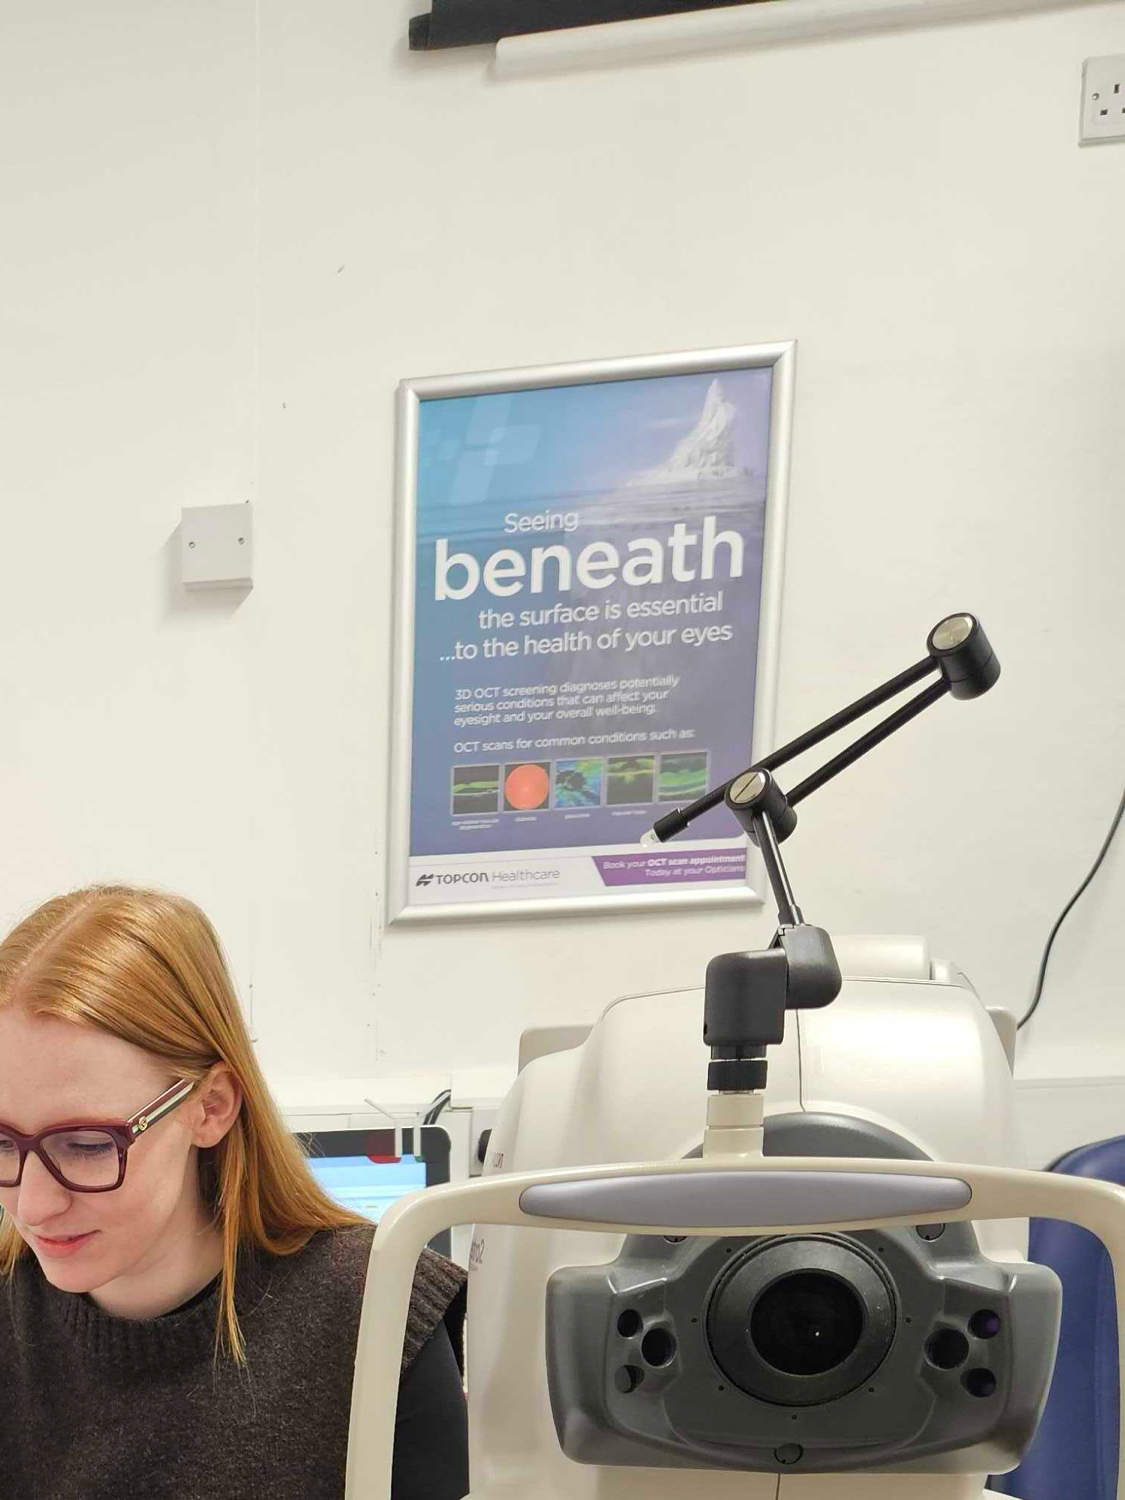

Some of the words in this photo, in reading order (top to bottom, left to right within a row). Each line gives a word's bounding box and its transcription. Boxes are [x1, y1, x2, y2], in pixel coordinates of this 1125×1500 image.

[504, 509, 579, 533] Seeing
[434, 515, 745, 601] beneath
[478, 608, 513, 629] the
[520, 603, 598, 626] surface
[604, 600, 622, 620] is
[627, 591, 724, 618] essential
[483, 637, 519, 658] the
[524, 631, 592, 655] health
[597, 628, 622, 649] of
[625, 628, 677, 651] your
[681, 623, 733, 645] eyes
[455, 688, 472, 700] 3D
[474, 687, 501, 698] OCT
[502, 684, 558, 697] screening
[559, 681, 617, 694] diagnoses
[620, 675, 681, 690] potentially
[454, 702, 494, 713] serious
[496, 697, 555, 710] conditions
[556, 695, 579, 706] that
[582, 694, 604, 705] can
[606, 691, 640, 703] affect
[642, 690, 670, 703] your
[454, 713, 502, 728] eyesight
[503, 711, 526, 723] and
[527, 711, 554, 723] your
[556, 707, 593, 719] overall
[454, 741, 481, 753] OCT
[482, 741, 515, 752] scans
[516, 738, 533, 749] for
[535, 736, 586, 748] common
[587, 731, 648, 744] conditions
[649, 728, 677, 740] such
[647, 858, 667, 867] OCT
[435, 872, 490, 885] TOPCON
[492, 869, 561, 882] Healthcare
